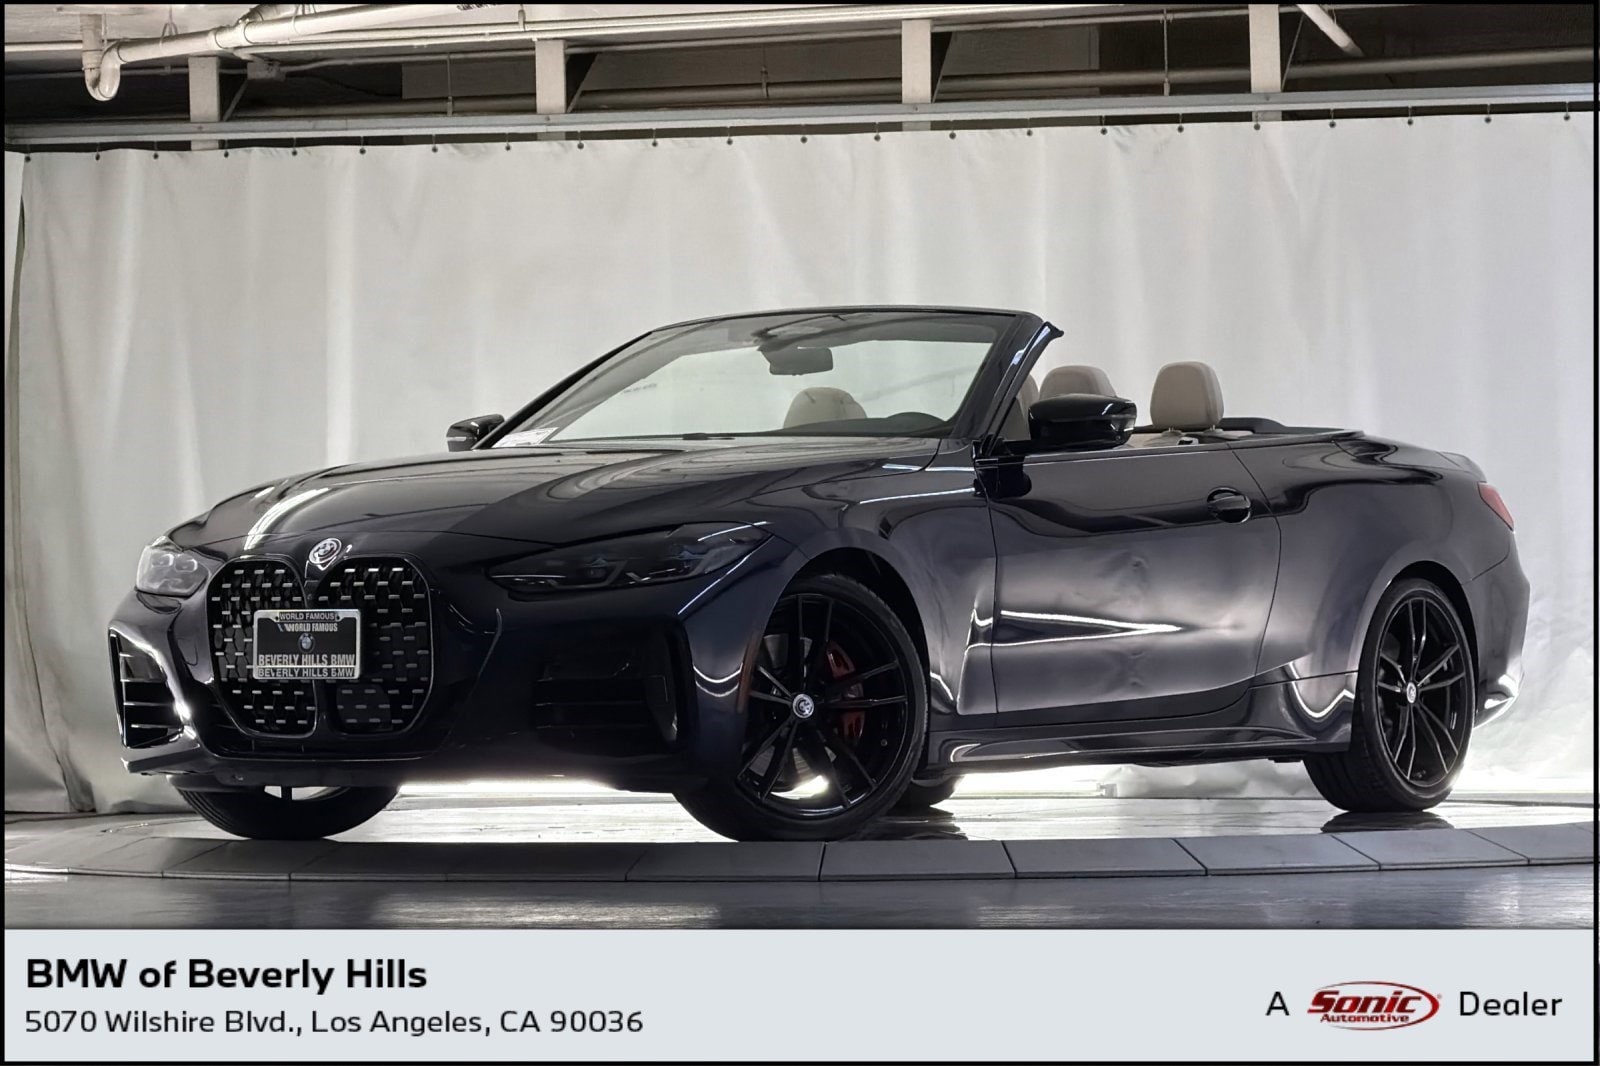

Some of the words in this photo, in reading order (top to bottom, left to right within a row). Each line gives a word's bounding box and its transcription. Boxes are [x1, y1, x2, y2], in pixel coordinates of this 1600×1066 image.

[279, 612, 304, 620] WORLD
[305, 612, 335, 620] FAMOUS
[284, 623, 311, 632] WORLD
[312, 623, 338, 632] FAMOUS
[258, 654, 299, 667] BEVERLY
[301, 654, 328, 666] HILLS
[330, 654, 355, 666] BMW
[258, 668, 300, 677] BEVERLY
[302, 668, 329, 677] HILLS
